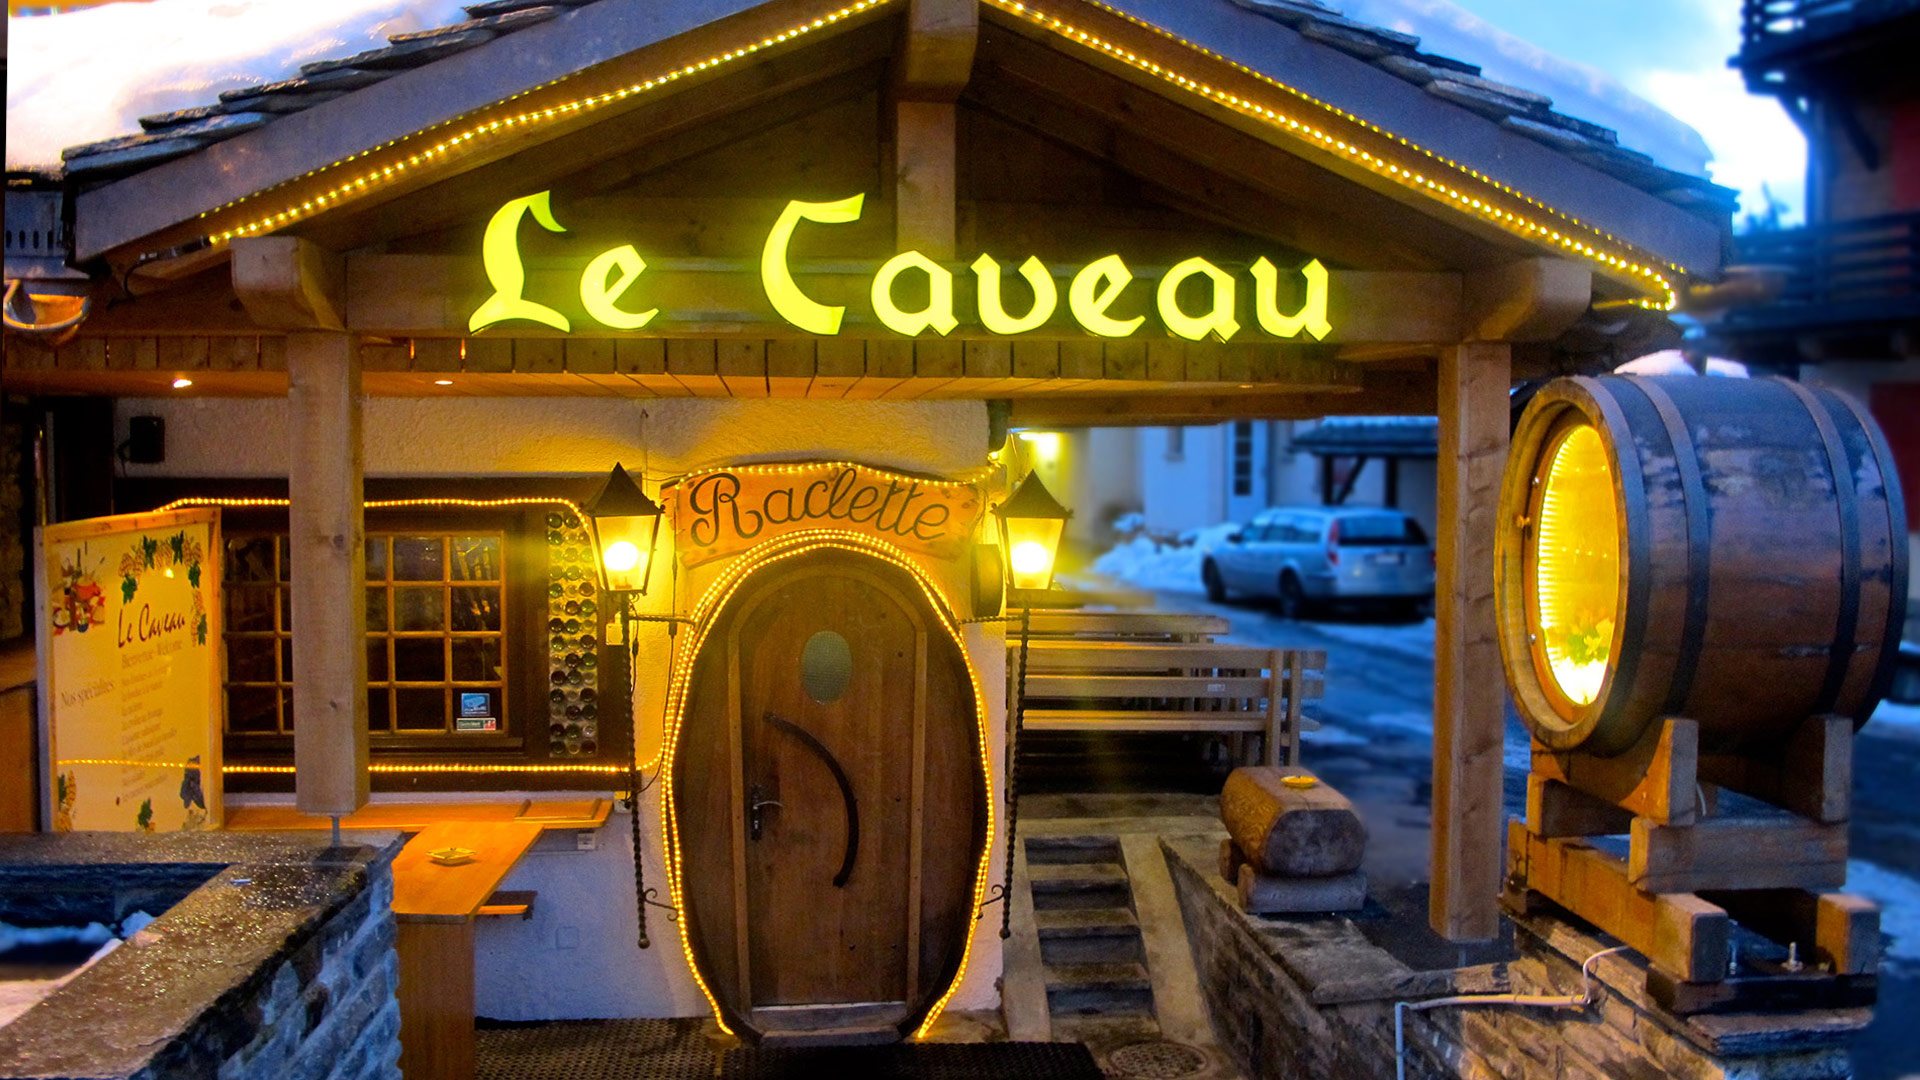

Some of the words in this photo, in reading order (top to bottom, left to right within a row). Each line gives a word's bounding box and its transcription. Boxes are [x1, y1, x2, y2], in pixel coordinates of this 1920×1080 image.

[468, 189, 660, 336] Le
[760, 192, 1333, 344] Caveau
[689, 466, 950, 548] Raclette
[118, 608, 133, 648] Le
[138, 603, 185, 642] Caveau
